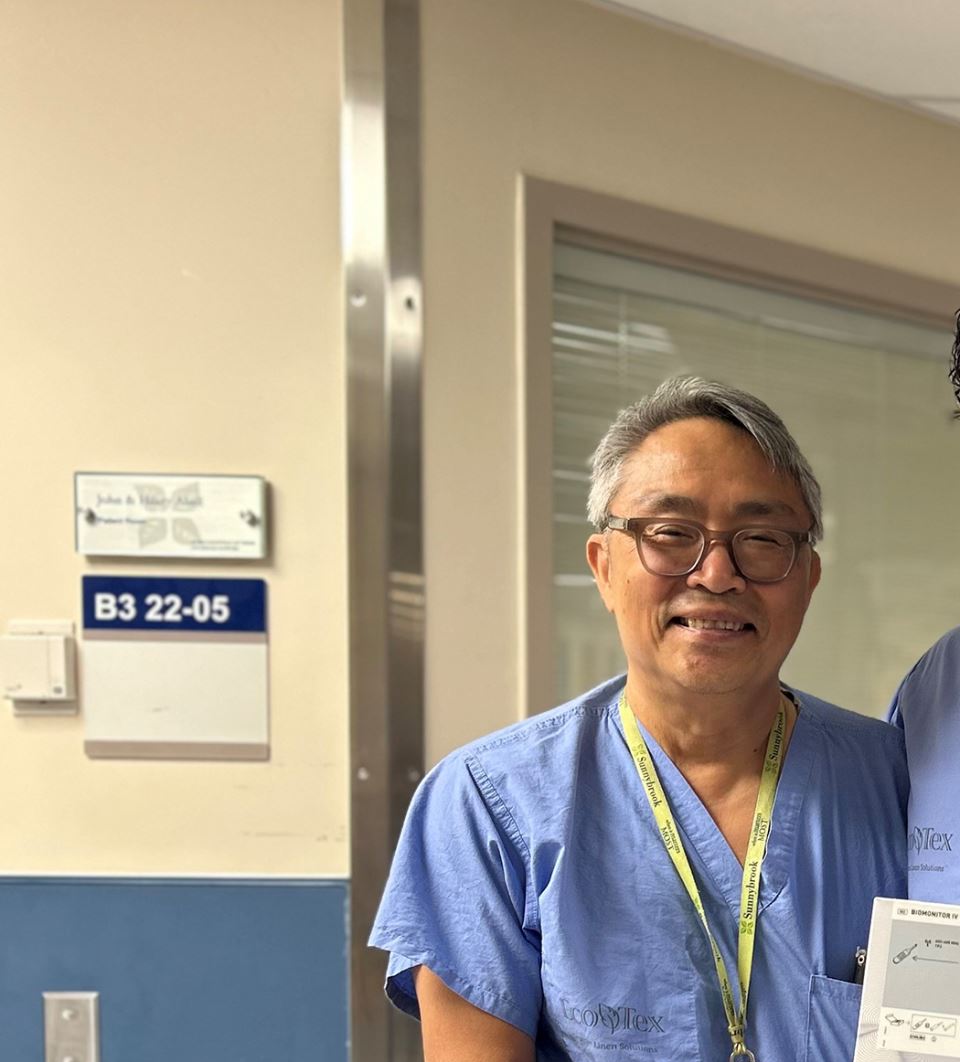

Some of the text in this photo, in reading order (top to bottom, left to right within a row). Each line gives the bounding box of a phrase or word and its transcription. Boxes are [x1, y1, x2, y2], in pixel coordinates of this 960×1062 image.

[94, 592, 231, 623] B3 22-05
[637, 756, 663, 808] Sunnybrook
[660, 827, 675, 851] MOST
[758, 819, 769, 842] MOST
[743, 861, 758, 920] Sunnybrook
[911, 909, 951, 919] BIOMONITOR
